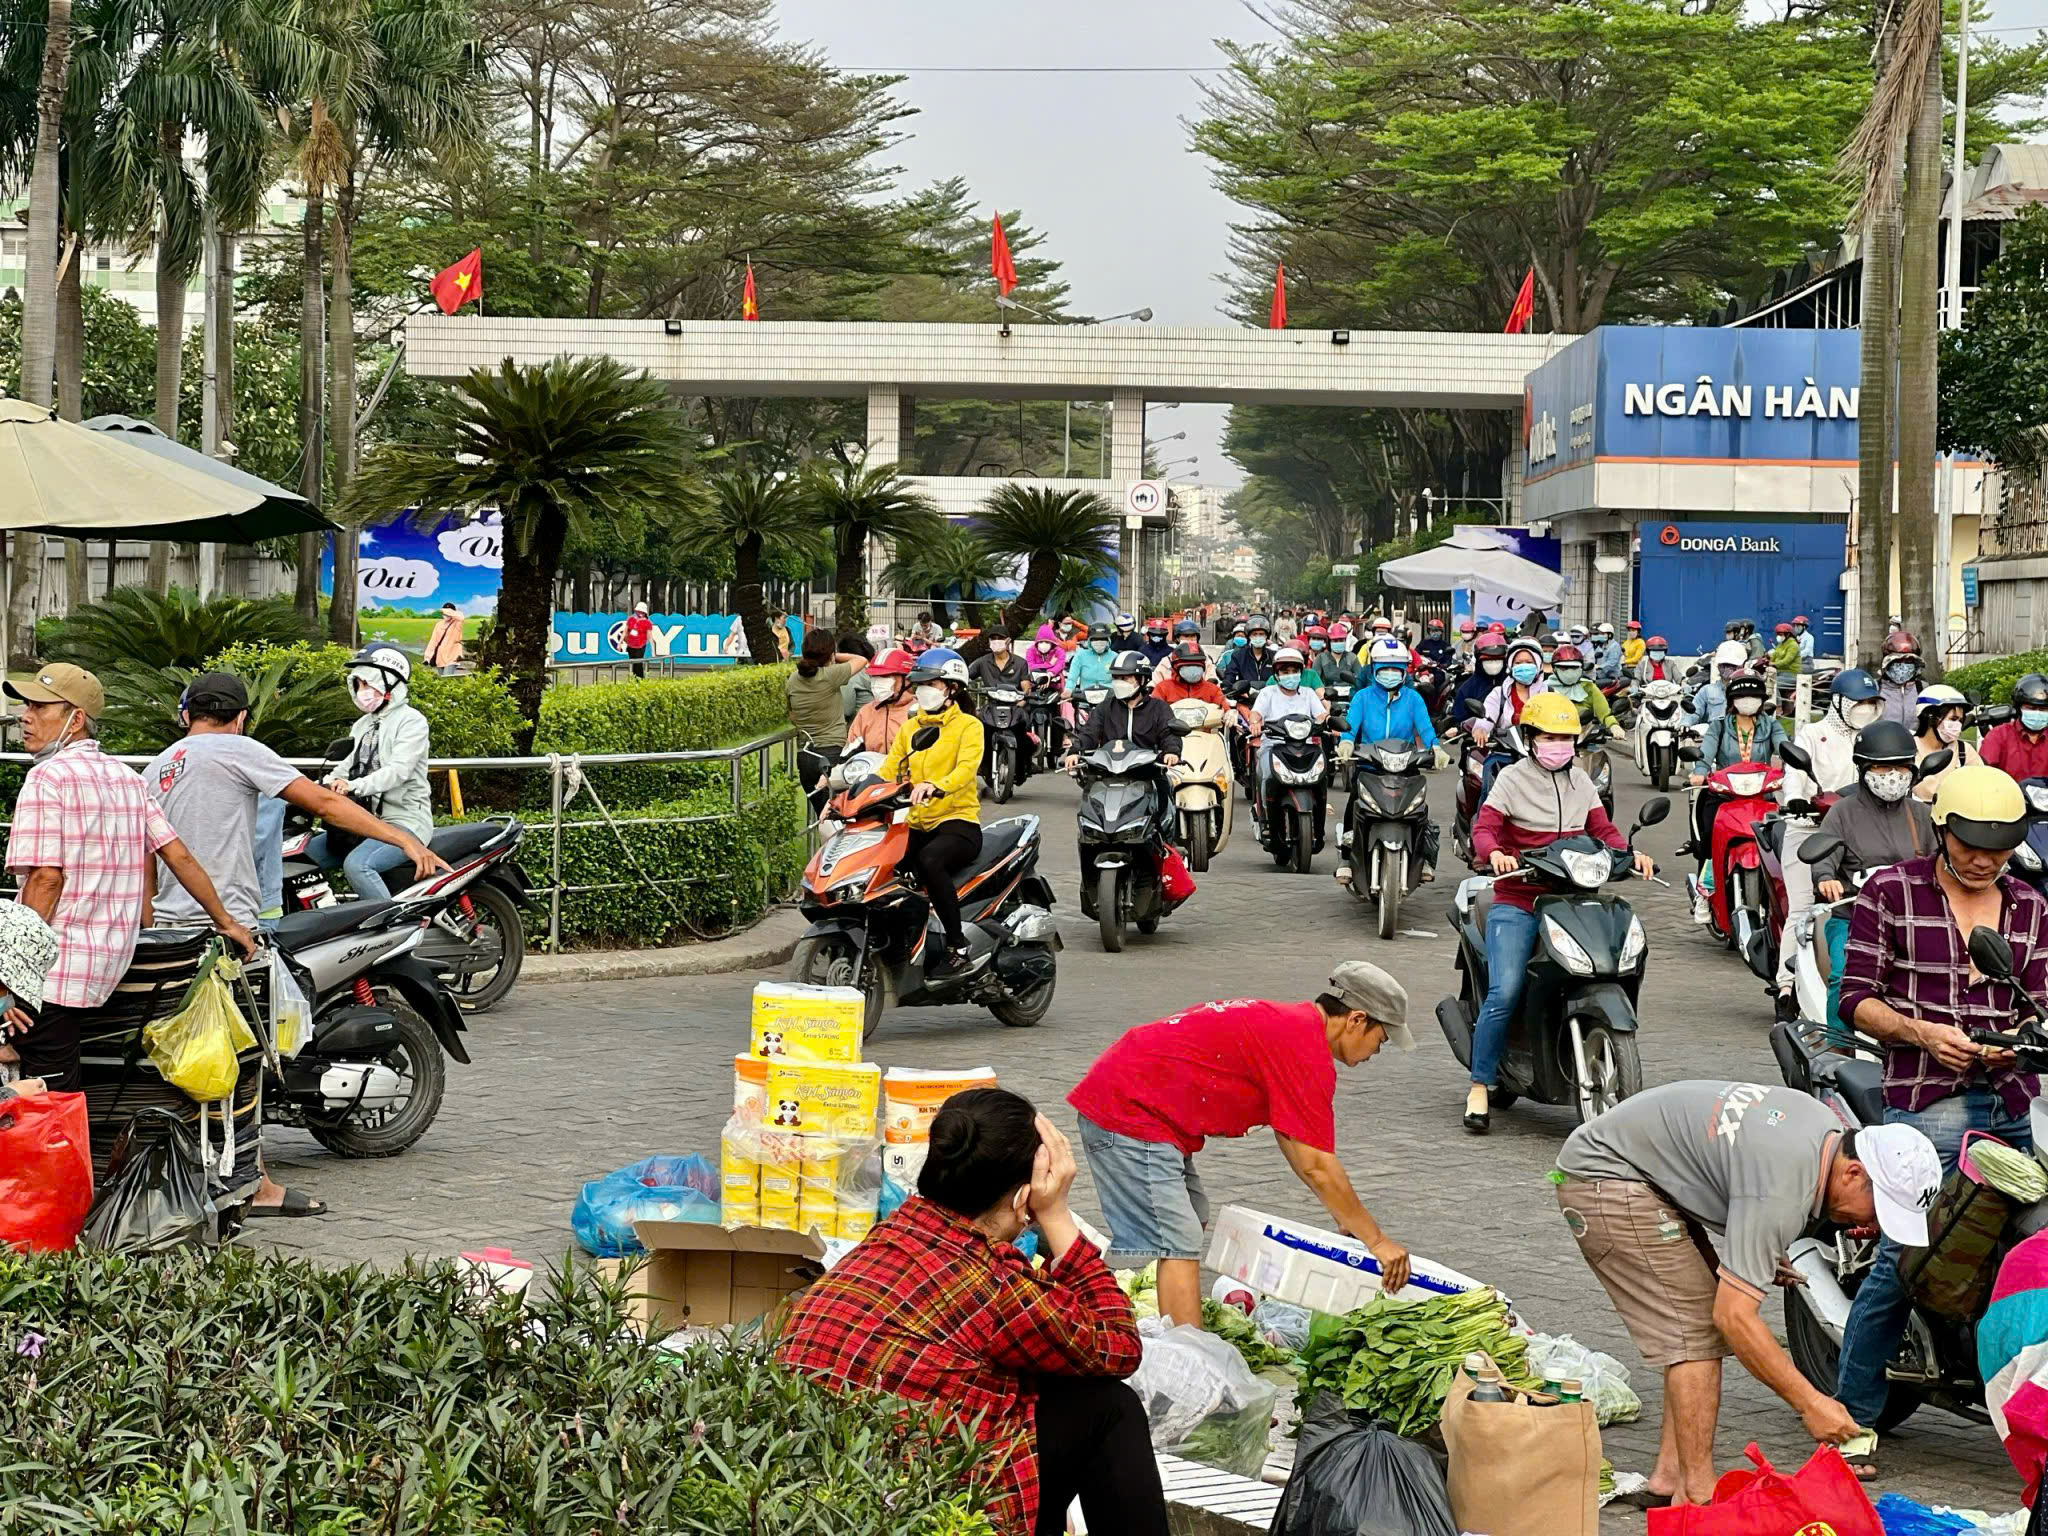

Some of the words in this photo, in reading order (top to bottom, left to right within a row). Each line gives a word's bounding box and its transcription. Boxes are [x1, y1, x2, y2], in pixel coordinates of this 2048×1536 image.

[1623, 375, 1752, 418] NGÂN
[1740, 536, 1781, 553] Bank
[357, 567, 417, 590] Vui
